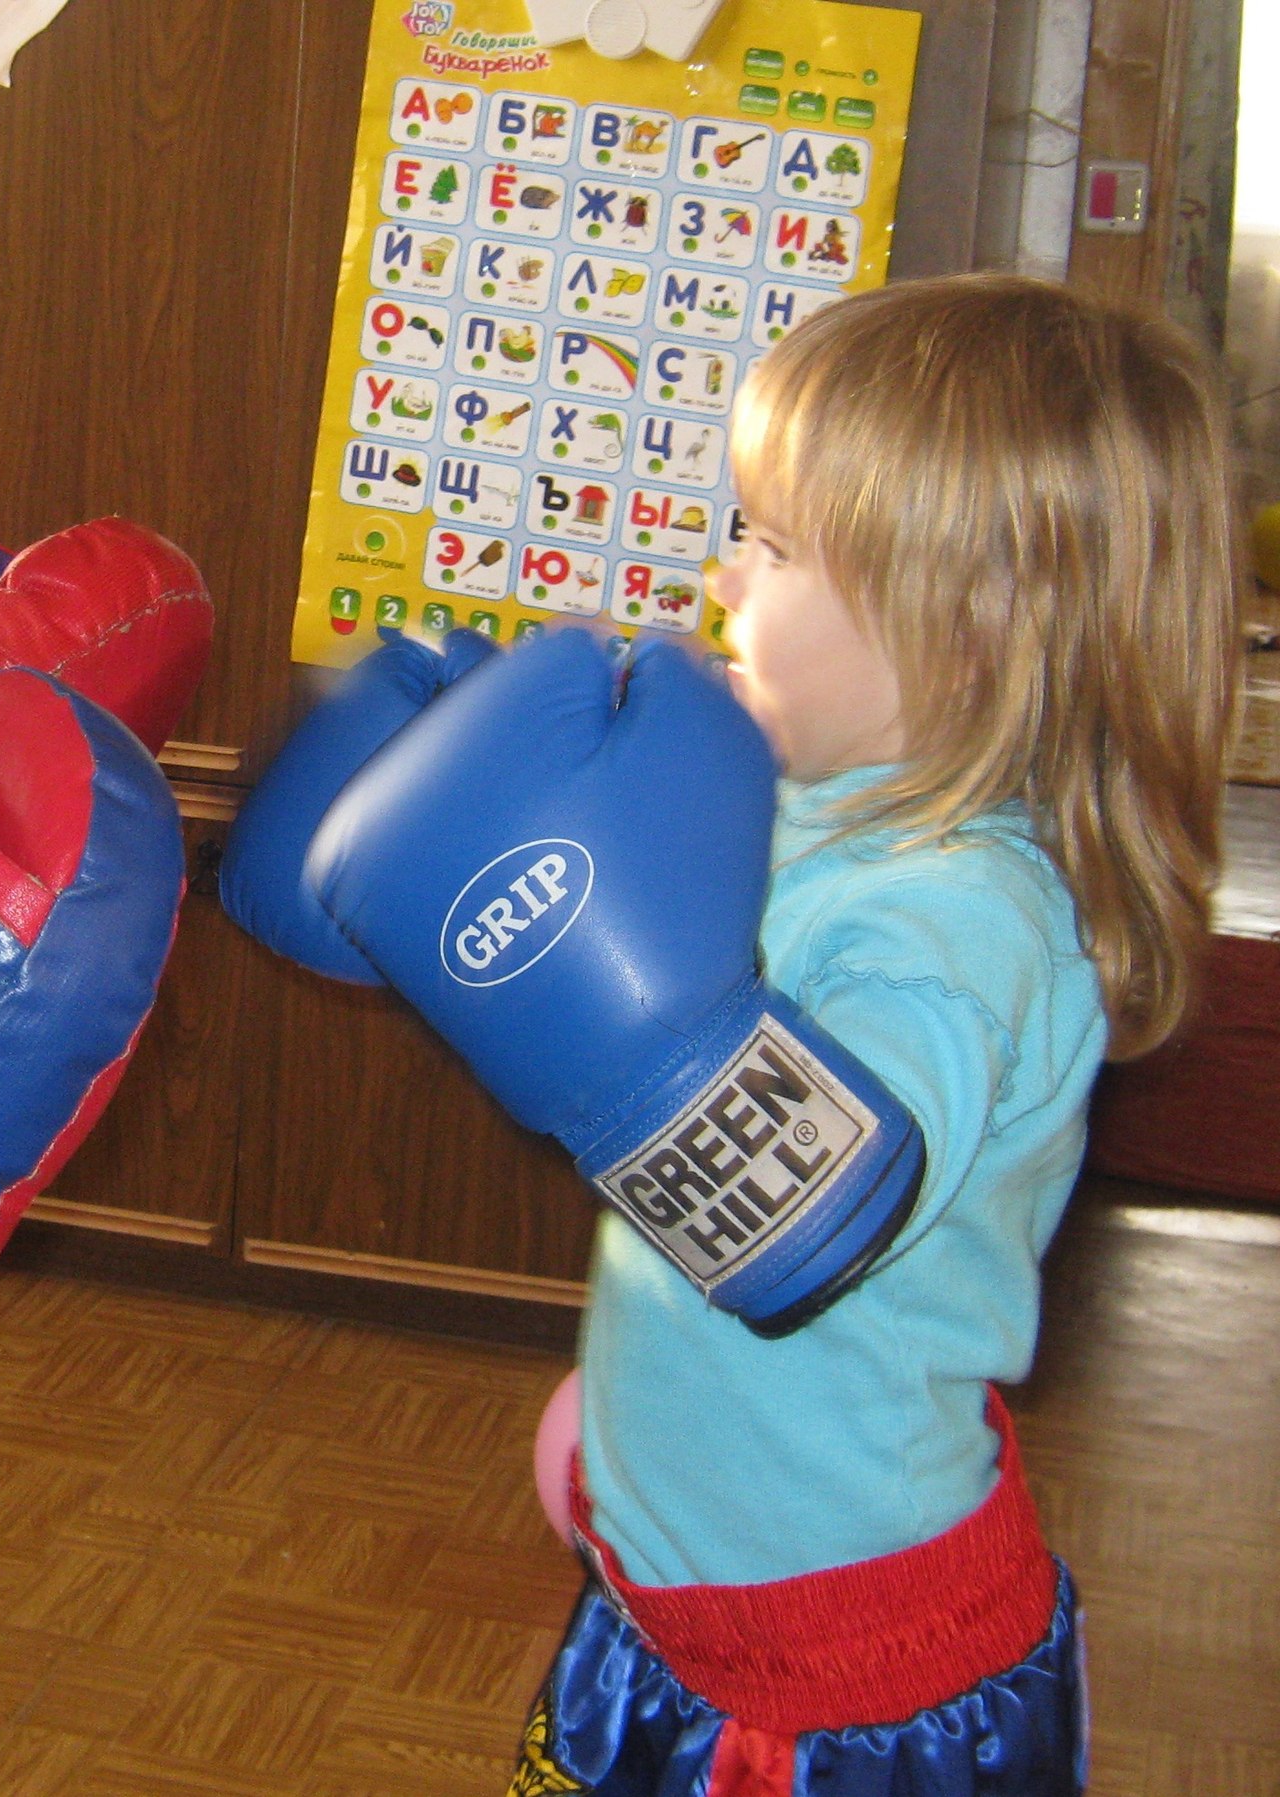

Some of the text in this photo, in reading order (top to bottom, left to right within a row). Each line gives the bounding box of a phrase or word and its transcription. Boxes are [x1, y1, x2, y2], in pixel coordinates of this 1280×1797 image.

[411, 1, 441, 18] JOY
[415, 19, 448, 36] TOY
[401, 87, 431, 122] А
[498, 98, 527, 135] Б
[591, 111, 621, 147] В
[691, 125, 718, 158] Г
[783, 138, 818, 180] Д
[394, 160, 422, 195] Е
[489, 162, 517, 209] Ё
[577, 186, 618, 223] Ж
[383, 224, 413, 266] Й
[776, 213, 808, 251] И
[478, 244, 505, 279] К
[568, 259, 597, 294] Л
[664, 274, 700, 311] М
[763, 289, 795, 326] Н
[371, 303, 405, 338] О
[466, 317, 496, 352] П
[560, 332, 589, 365] Р
[656, 347, 686, 383] С
[366, 375, 395, 410] У
[455, 390, 489, 426] Ф
[550, 406, 578, 441] Х
[643, 417, 674, 460] Ц
[349, 444, 390, 481] Ш
[439, 459, 481, 504] Щ
[536, 475, 570, 511] Ъ
[630, 491, 672, 529] Ы
[436, 532, 465, 566] Э
[521, 546, 570, 585] Ю
[624, 564, 653, 599] Я
[340, 594, 352, 614] 1
[384, 602, 399, 622] 2
[431, 610, 445, 629] 3
[476, 618, 491, 635] 4
[456, 853, 569, 970] GRIP
[620, 1044, 812, 1229] GREEN
[683, 1141, 832, 1262] HILL
